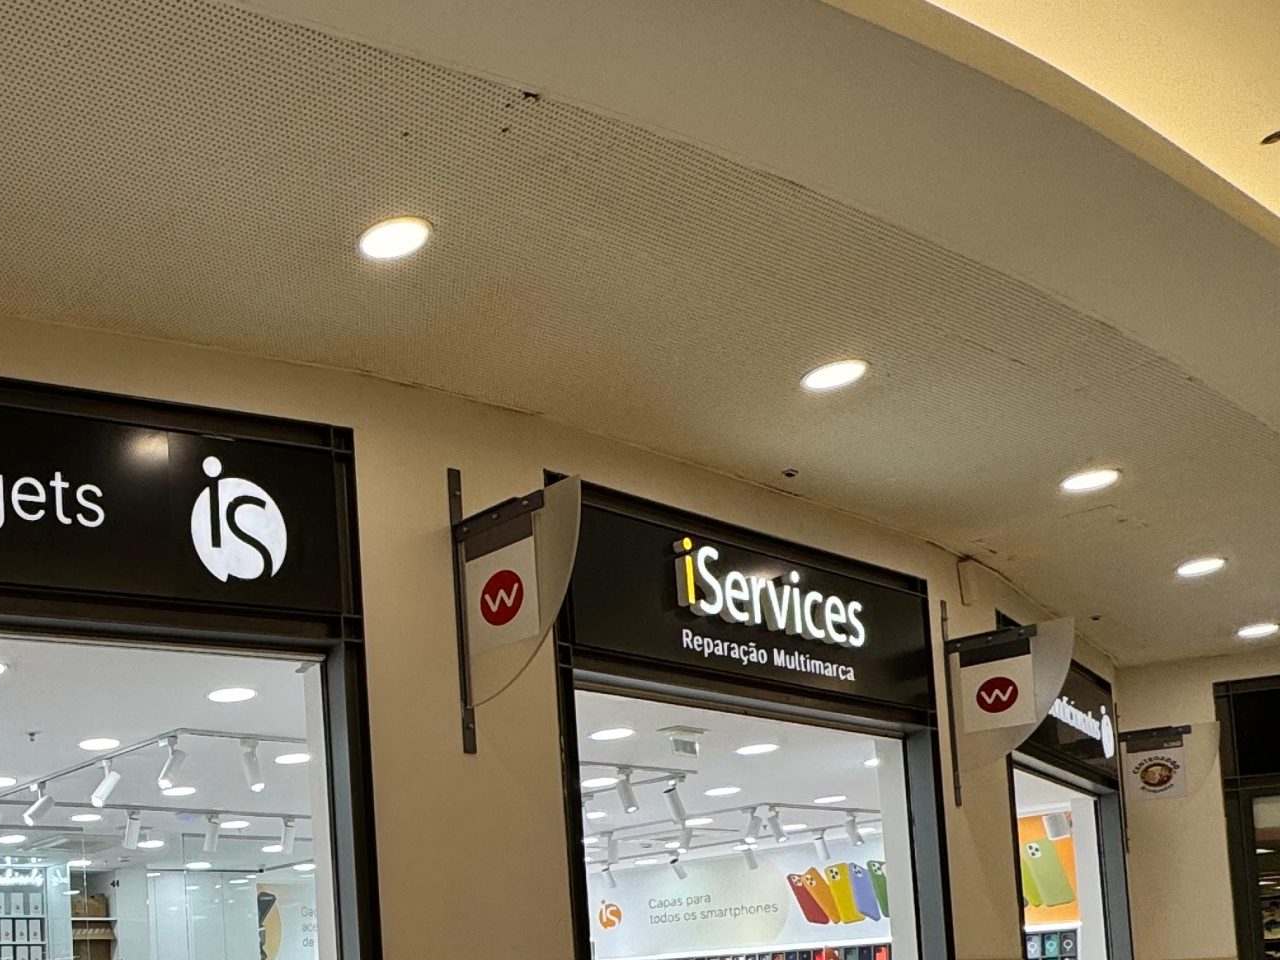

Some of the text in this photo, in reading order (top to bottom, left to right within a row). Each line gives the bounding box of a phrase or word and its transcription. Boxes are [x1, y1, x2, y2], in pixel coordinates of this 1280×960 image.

[680, 536, 866, 648] iServices
[681, 628, 856, 682] Reparação Multimarca
[648, 894, 712, 910] Capas para
[649, 902, 779, 924] todos os smartphones
